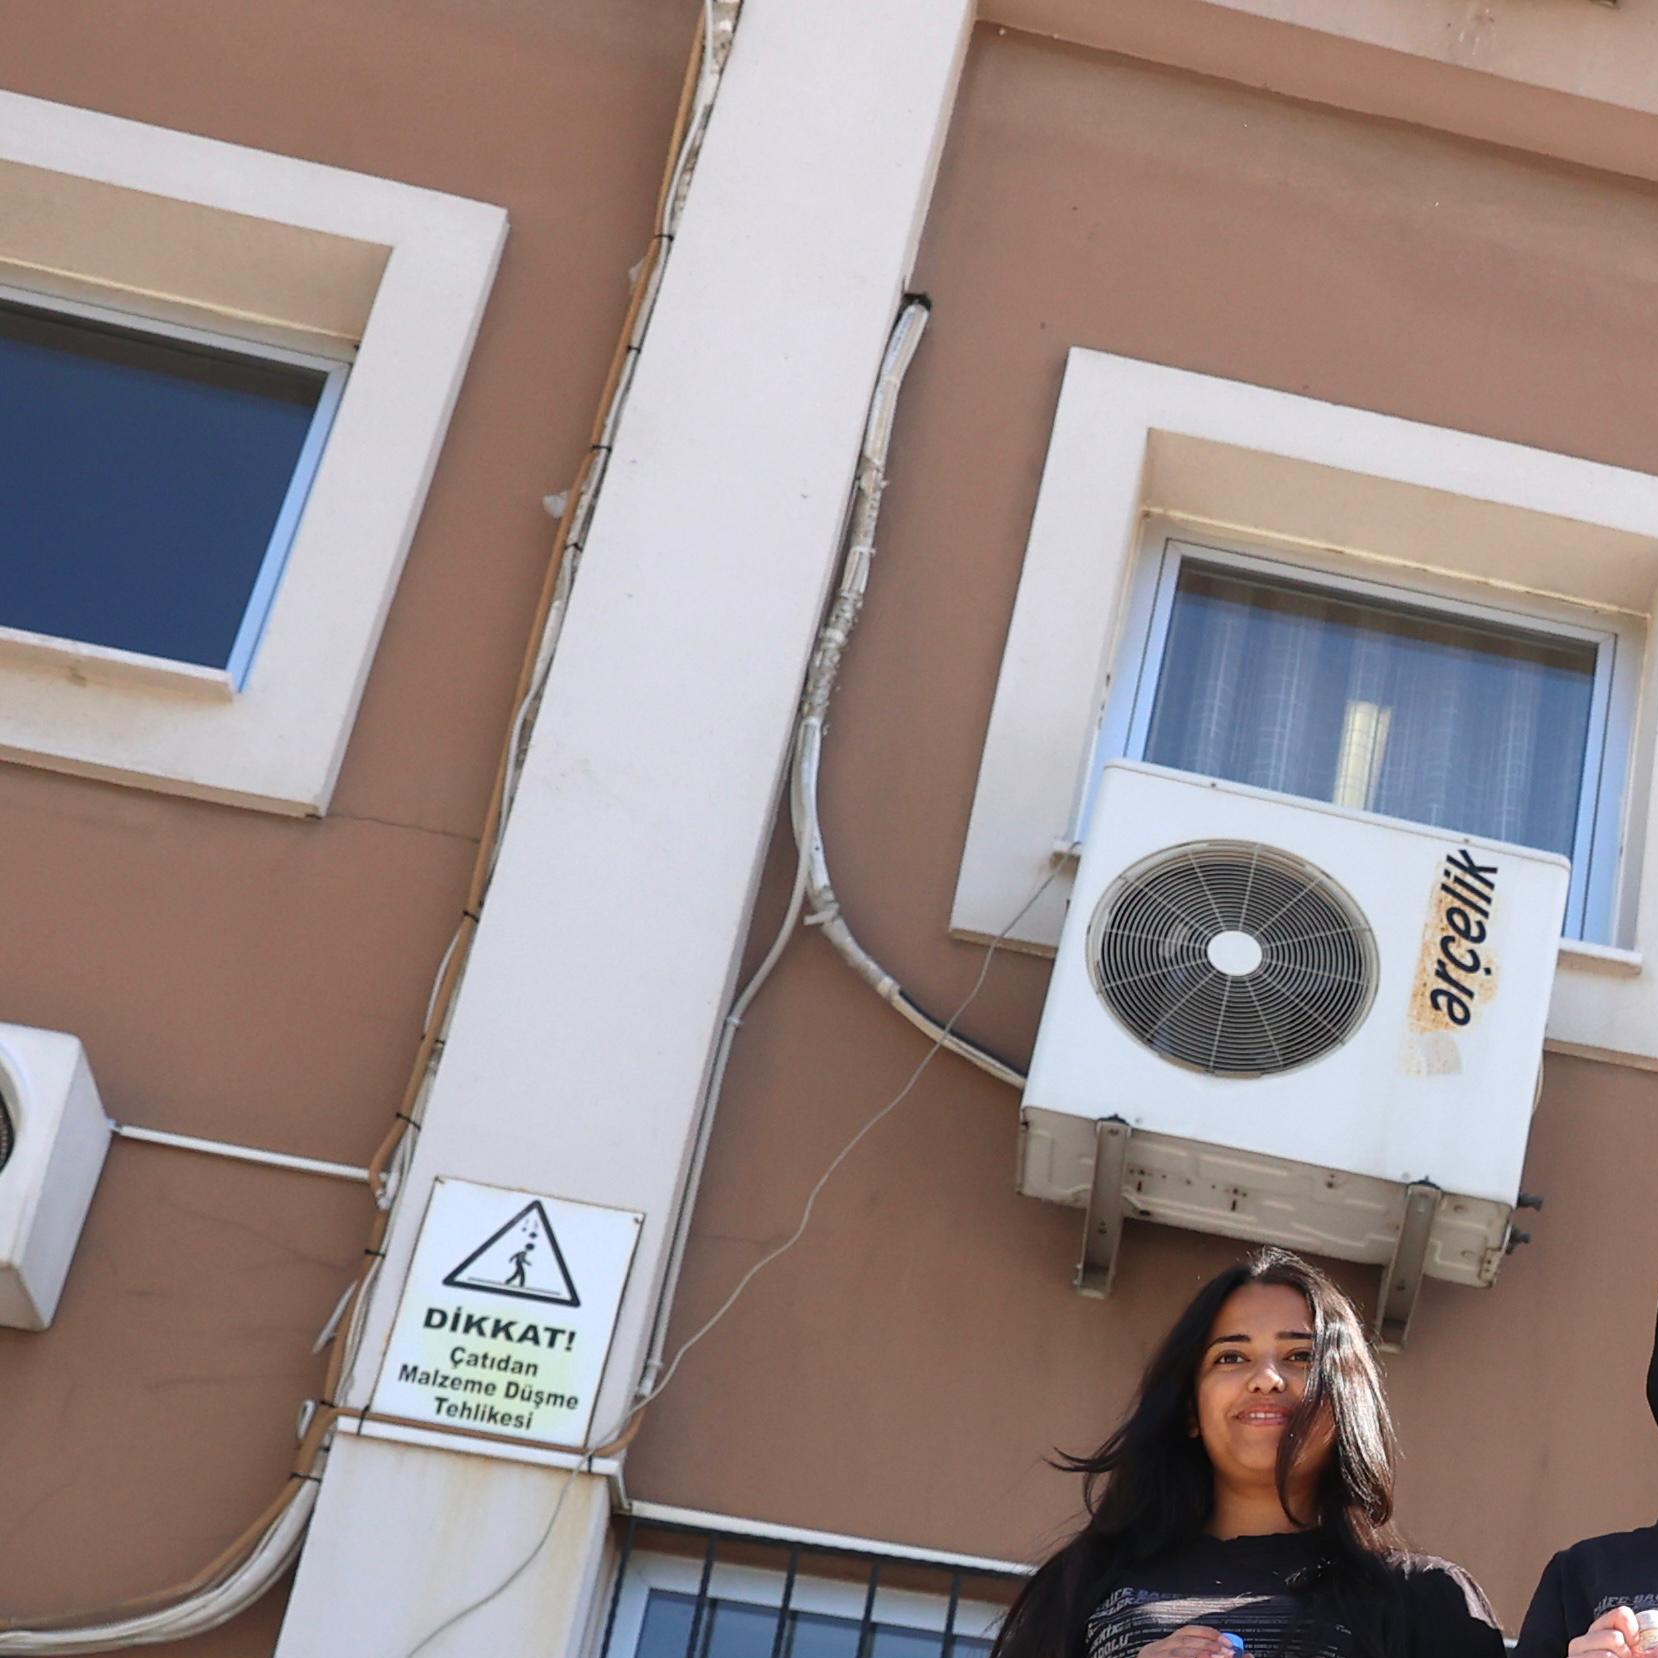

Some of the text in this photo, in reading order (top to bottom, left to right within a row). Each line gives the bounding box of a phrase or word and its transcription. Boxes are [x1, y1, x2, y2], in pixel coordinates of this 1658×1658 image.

[1429, 849, 1498, 1027] arçelik
[423, 1306, 577, 1351] DİKKAT!
[450, 1346, 538, 1377] Çatıdan
[398, 1364, 579, 1410] Malzeme Düşme
[434, 1397, 533, 1430] Tehlikesi
